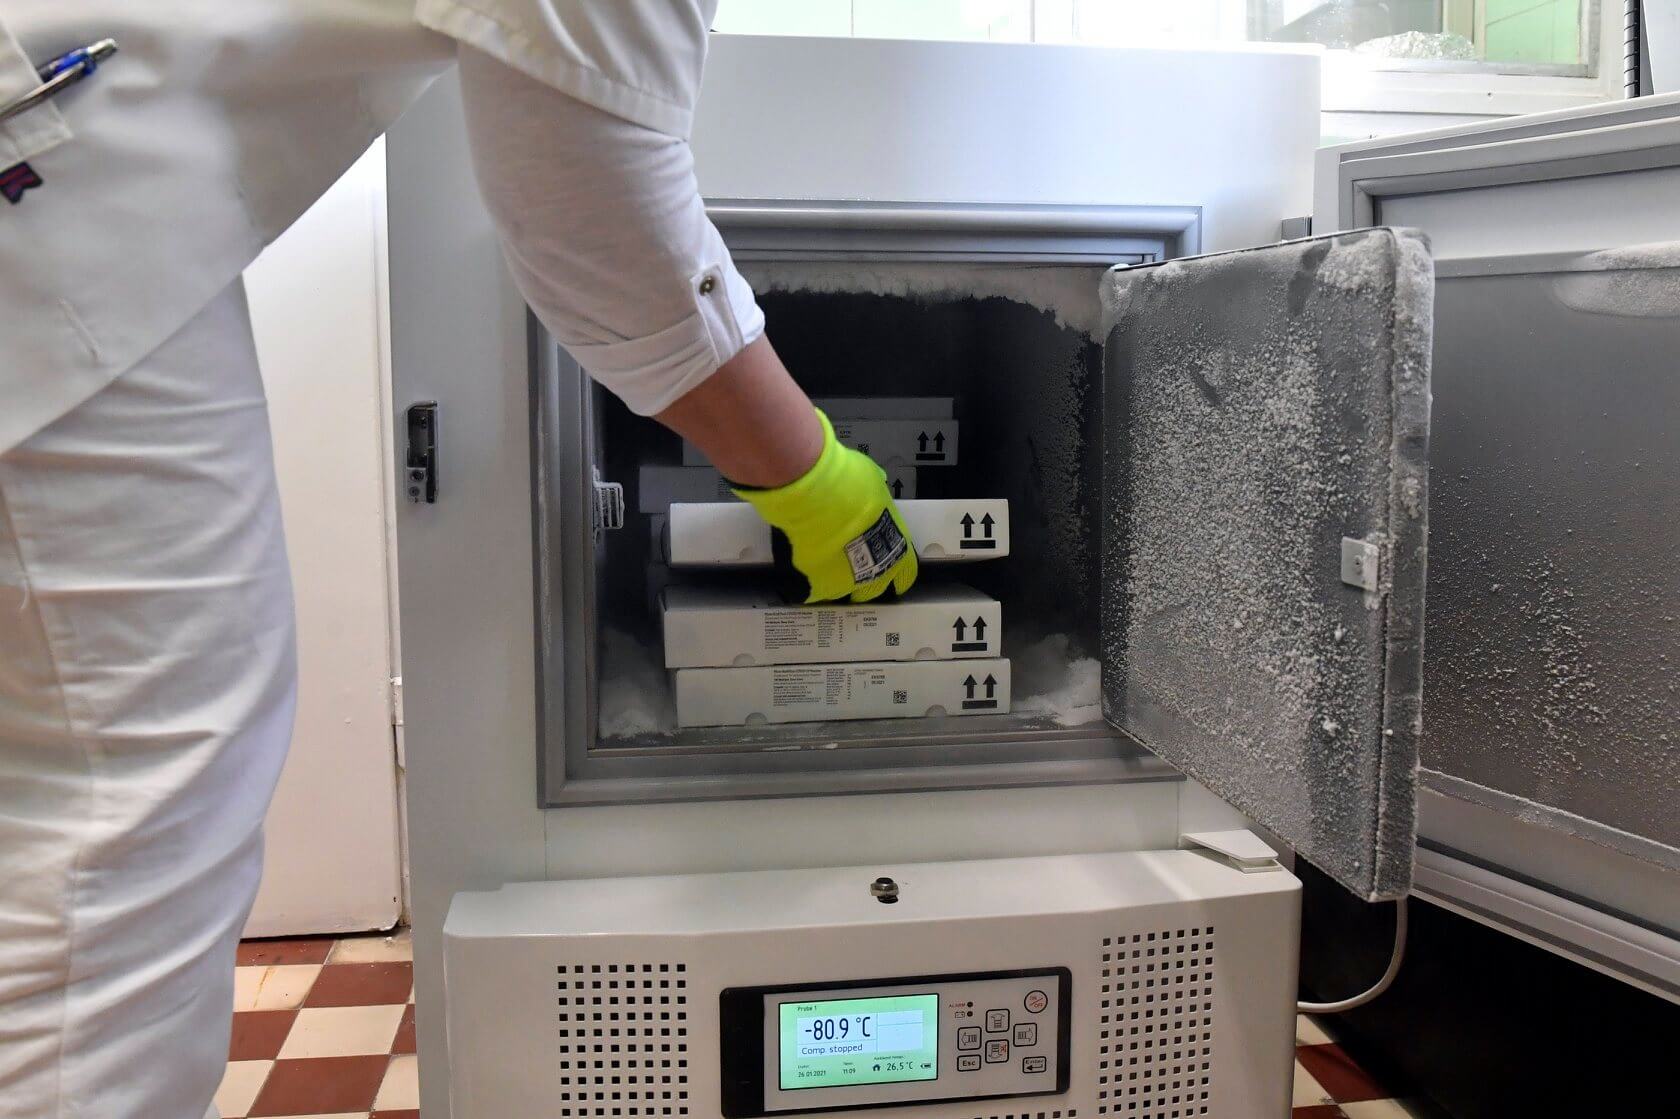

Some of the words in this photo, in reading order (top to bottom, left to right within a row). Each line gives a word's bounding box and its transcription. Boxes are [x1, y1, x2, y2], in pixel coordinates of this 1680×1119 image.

[804, 1018, 849, 1040] -80.9
[856, 1016, 871, 1037] °C
[829, 1044, 863, 1054] stopped
